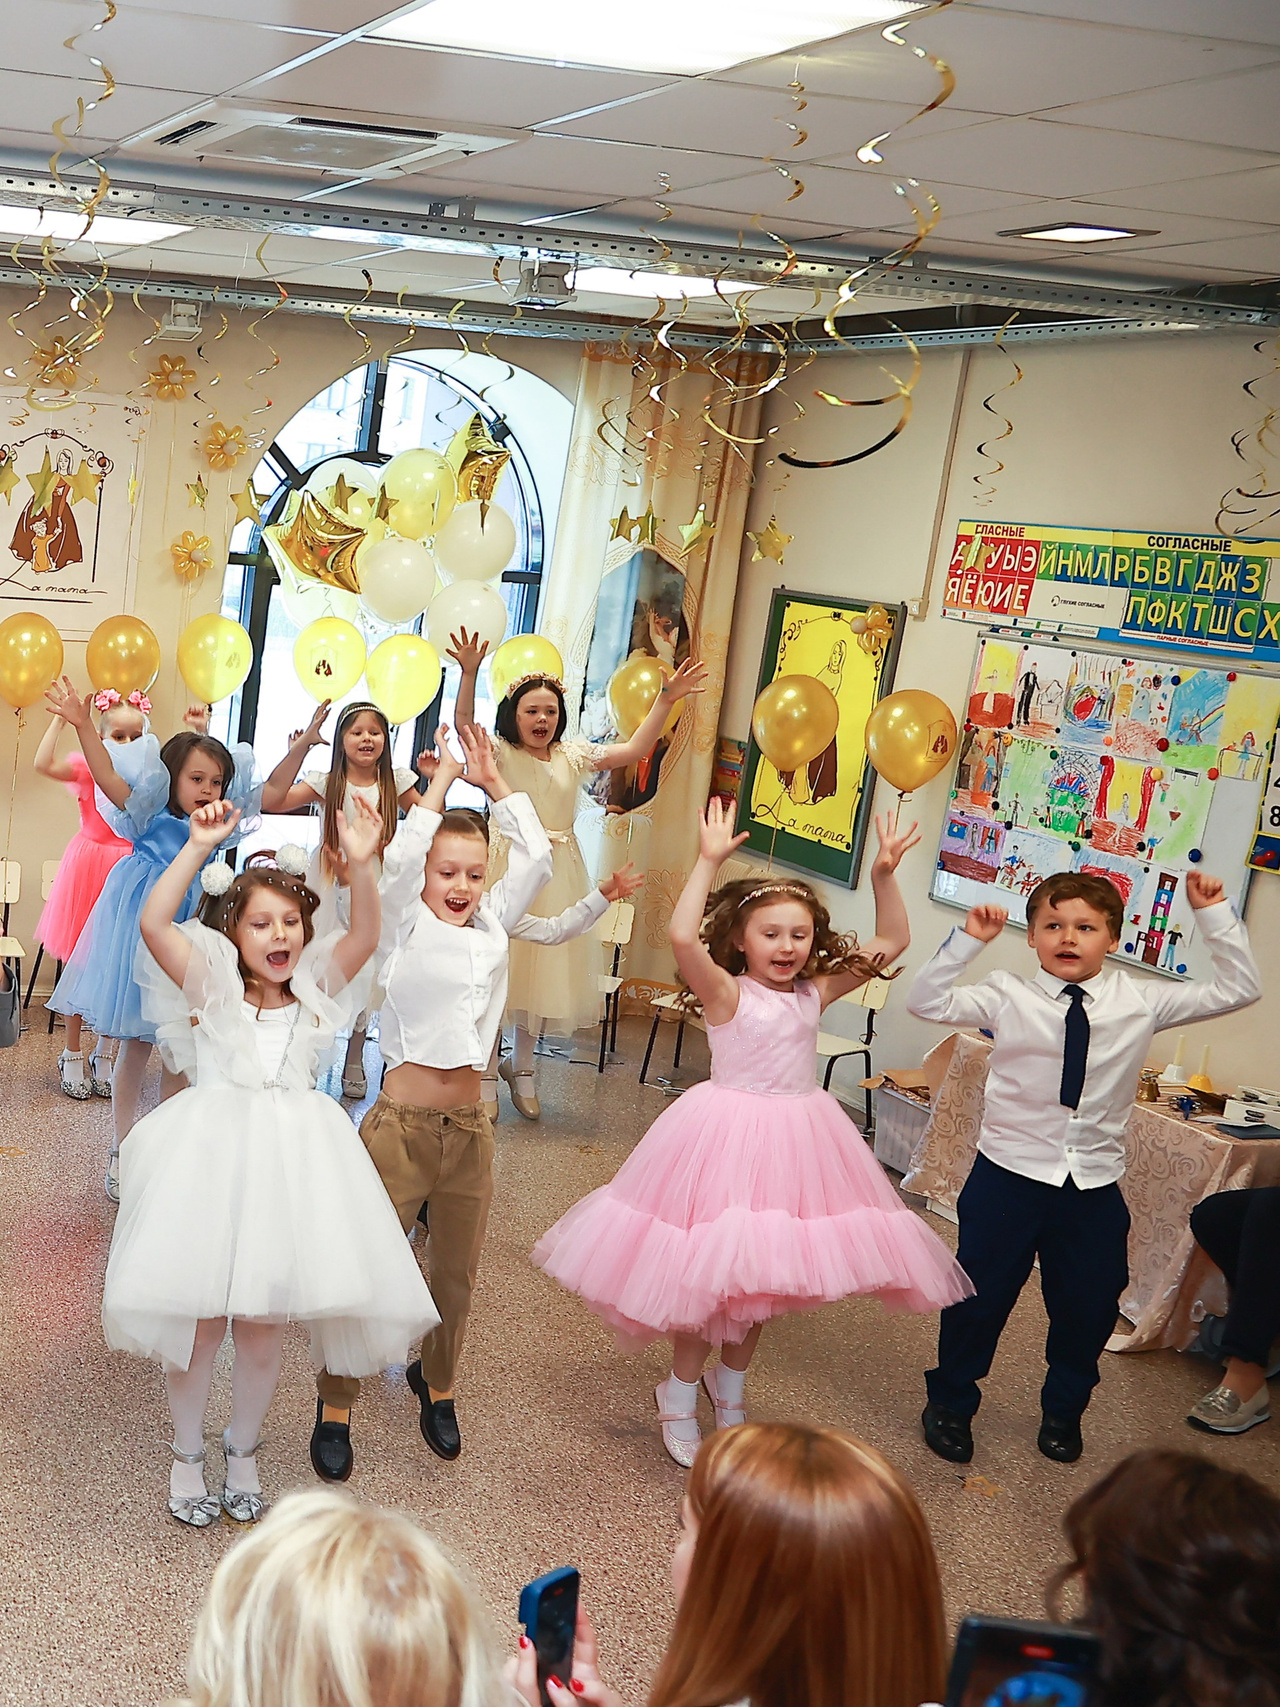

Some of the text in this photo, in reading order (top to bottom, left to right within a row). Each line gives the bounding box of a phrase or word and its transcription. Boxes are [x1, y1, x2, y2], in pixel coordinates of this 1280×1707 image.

[974, 524, 1025, 538] ГЛАСНЫЕ
[1147, 535, 1232, 553] СОГЛАСНЫЕ
[45, 585, 108, 595] mama
[1178, 637, 1209, 646] СОГЛАСНЫЕ
[755, 791, 849, 844] La mama
